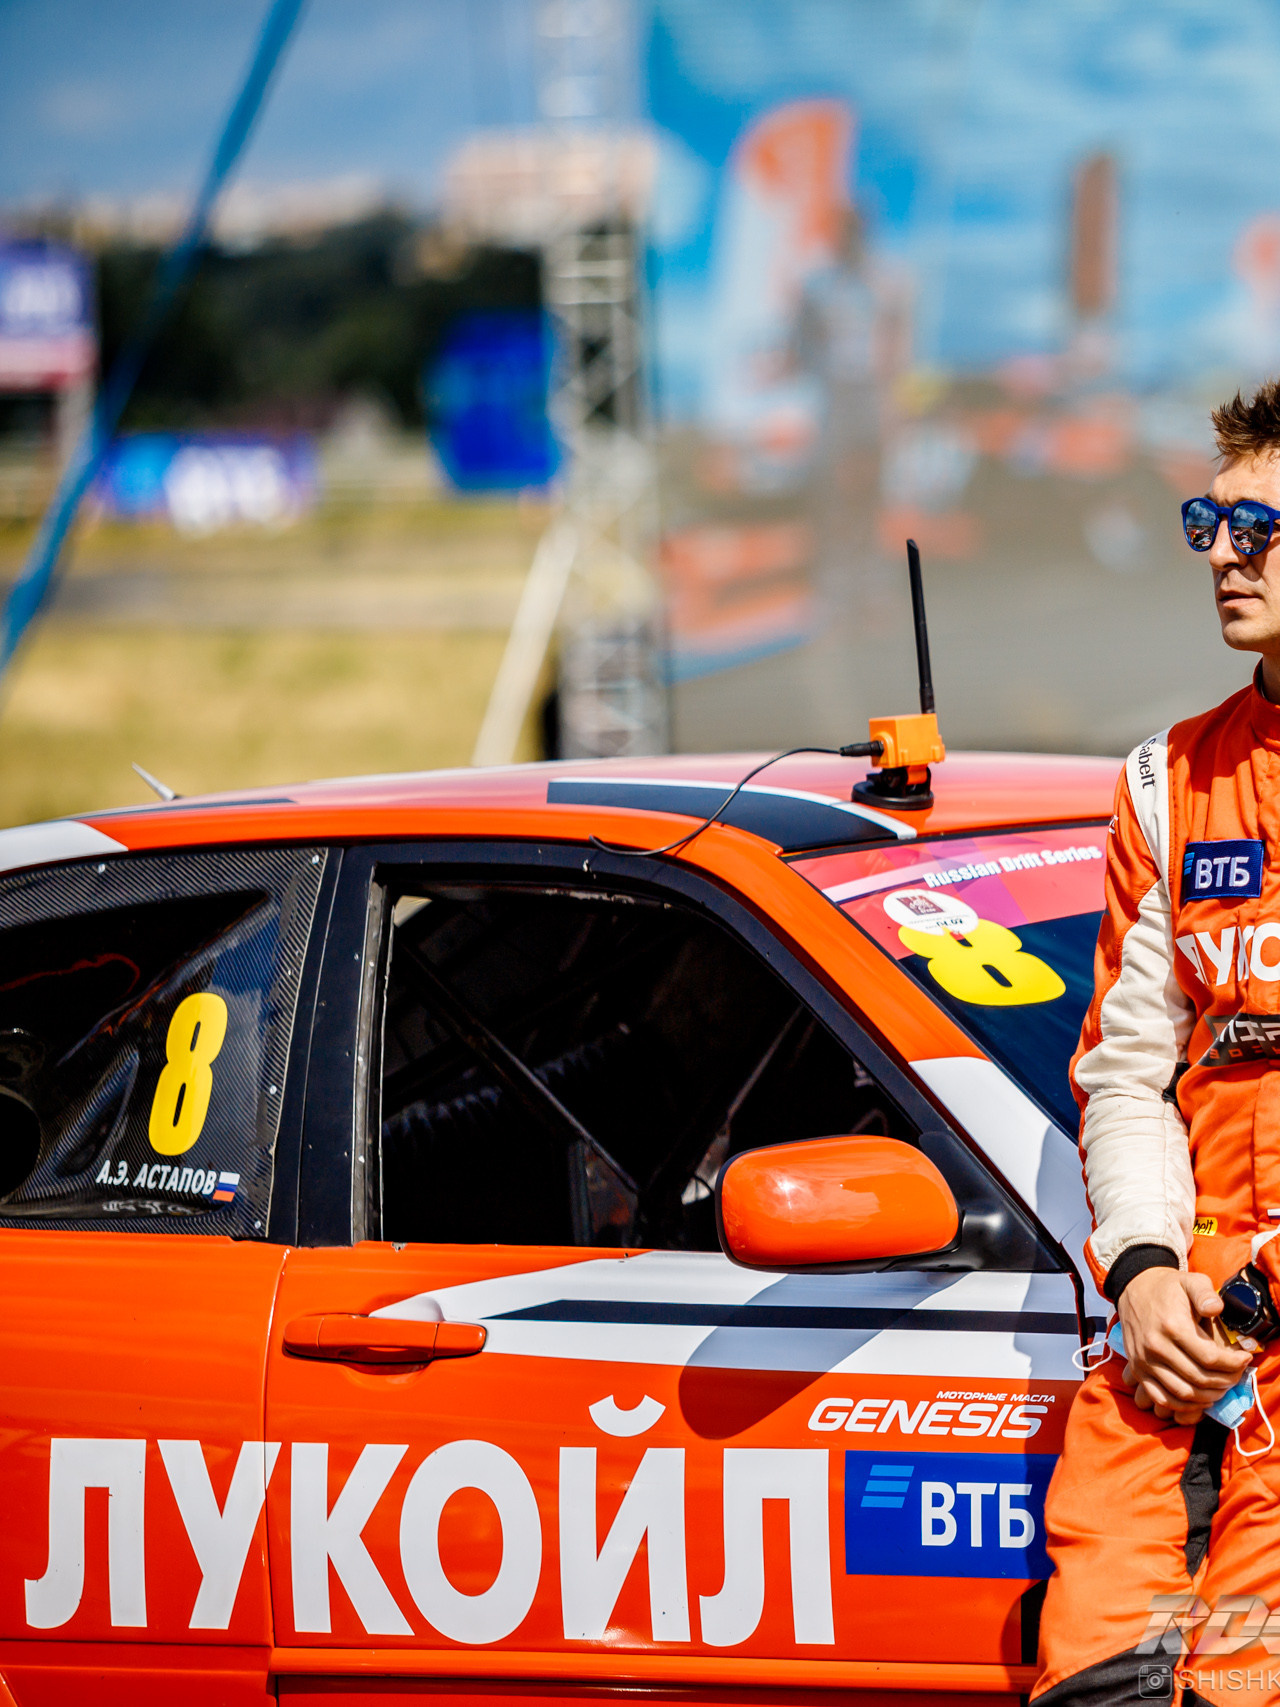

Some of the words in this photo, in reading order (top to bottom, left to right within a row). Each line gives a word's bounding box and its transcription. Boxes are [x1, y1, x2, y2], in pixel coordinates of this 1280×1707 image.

[1138, 738, 1157, 789] Sabelt
[922, 860, 1002, 888] Russian
[998, 852, 1045, 872] Drift
[1040, 845, 1103, 866] Series
[1194, 856, 1250, 889] ВТБ
[898, 918, 1067, 1007] 8
[148, 992, 229, 1156] 8
[96, 1159, 130, 1186] А.Э.
[133, 1163, 218, 1196] АСТАПОВ
[807, 1397, 1049, 1439] GENESIS
[936, 1390, 1008, 1402] МОТОРНЫЕ
[1010, 1393, 1056, 1403] МАСЛА
[23, 1394, 836, 1648] ЛУКОЙЛ
[921, 1481, 1036, 1549] ВТБ
